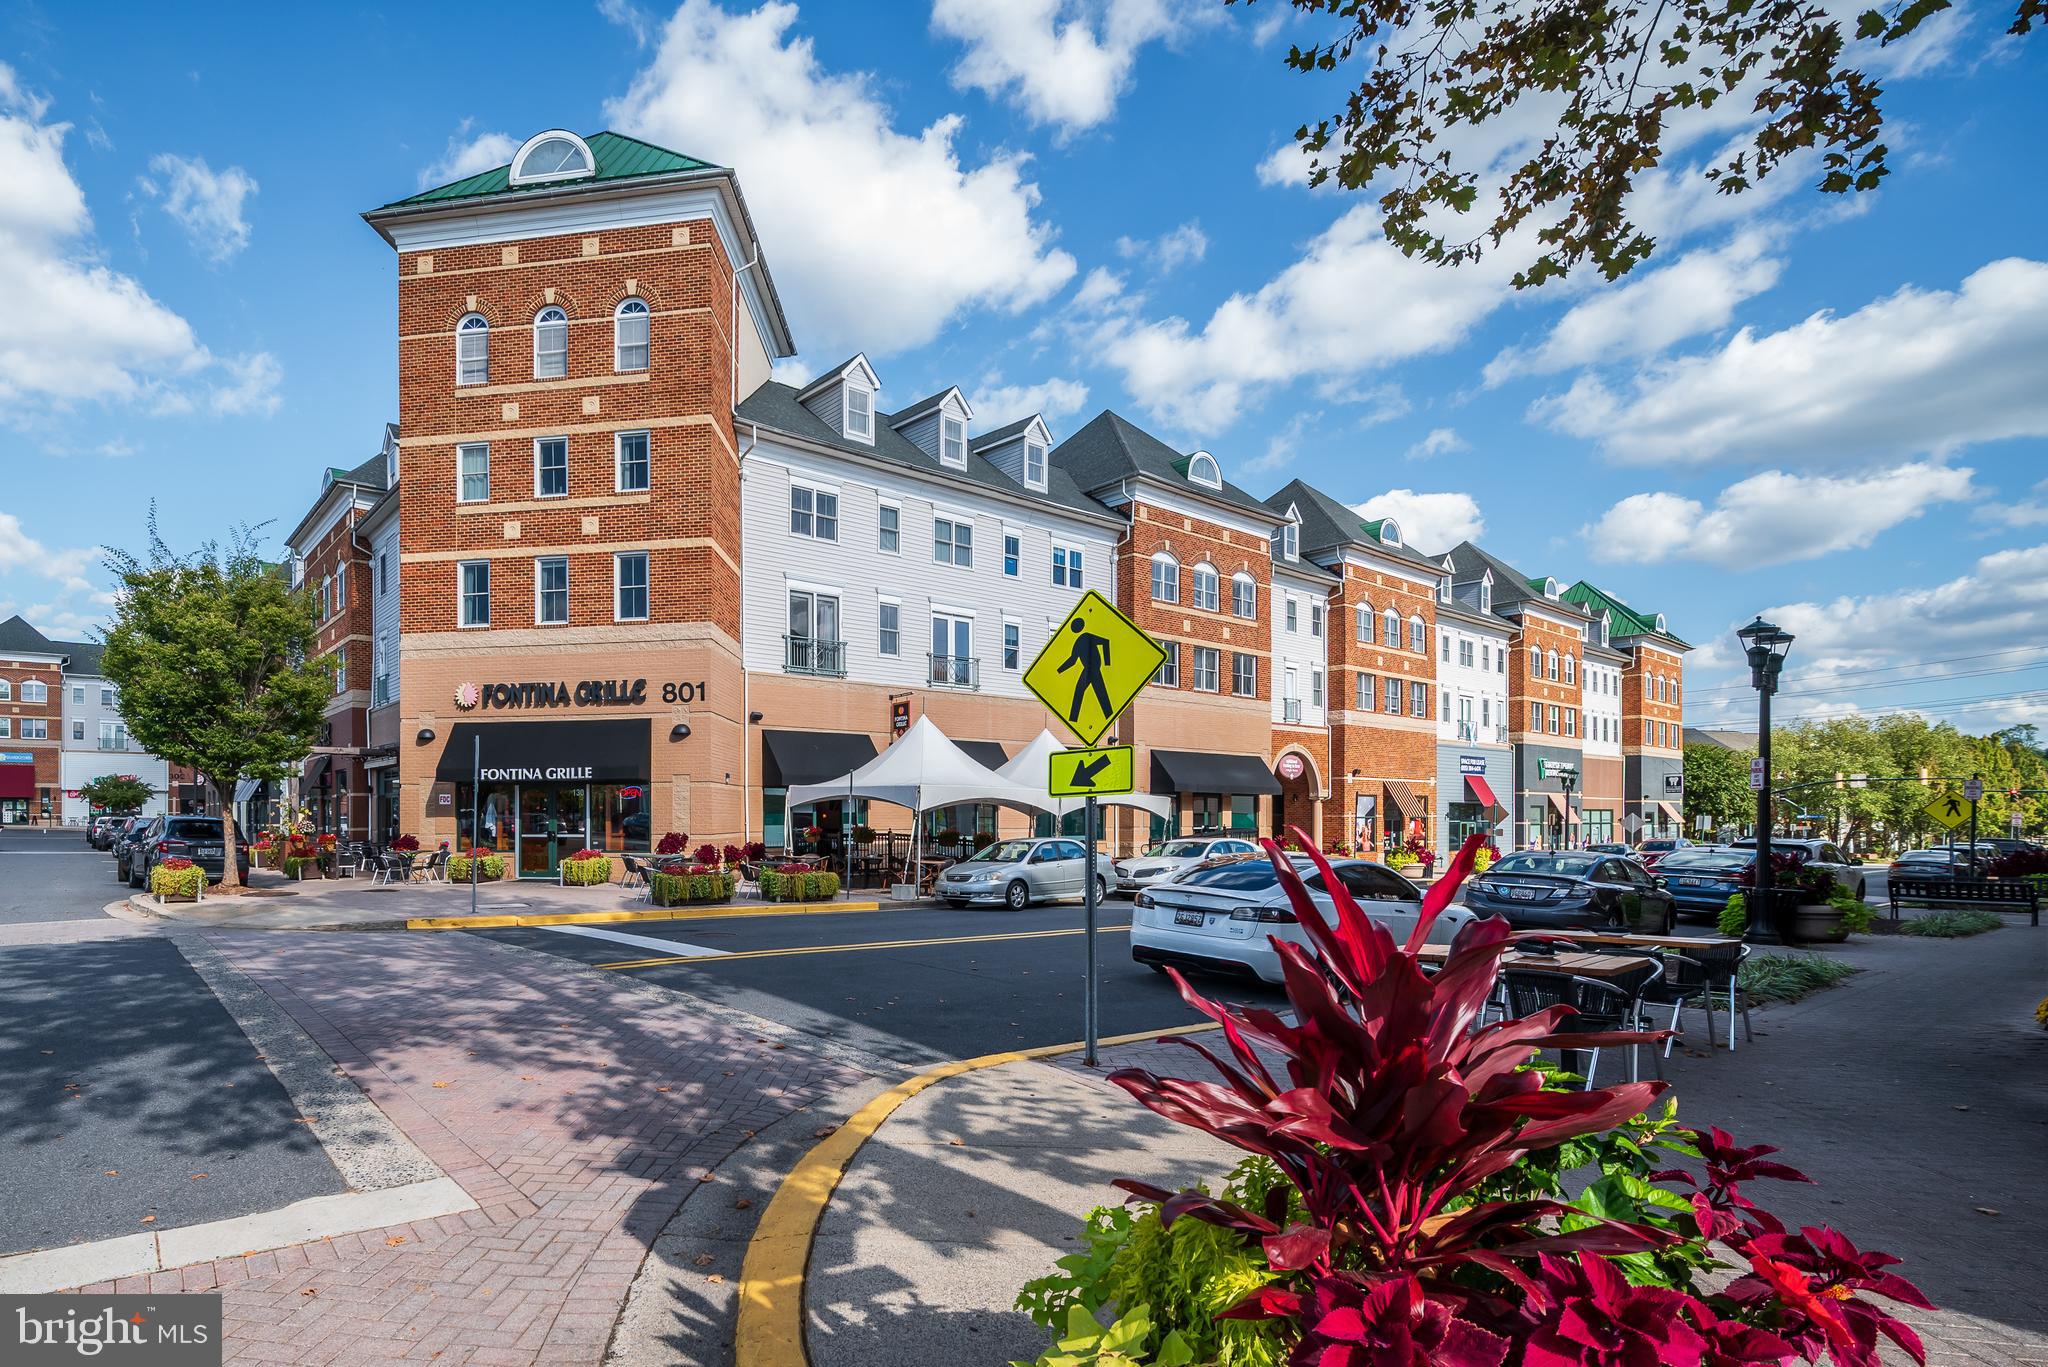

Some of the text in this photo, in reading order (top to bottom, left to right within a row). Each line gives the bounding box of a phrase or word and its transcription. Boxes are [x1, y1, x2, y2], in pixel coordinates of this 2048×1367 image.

[482, 679, 647, 709] FONTINA GRILLE
[662, 682, 706, 703] 801
[480, 767, 593, 781] FONTINA GRILLE
[439, 795, 451, 804] FDC
[621, 788, 643, 797] OPEN
